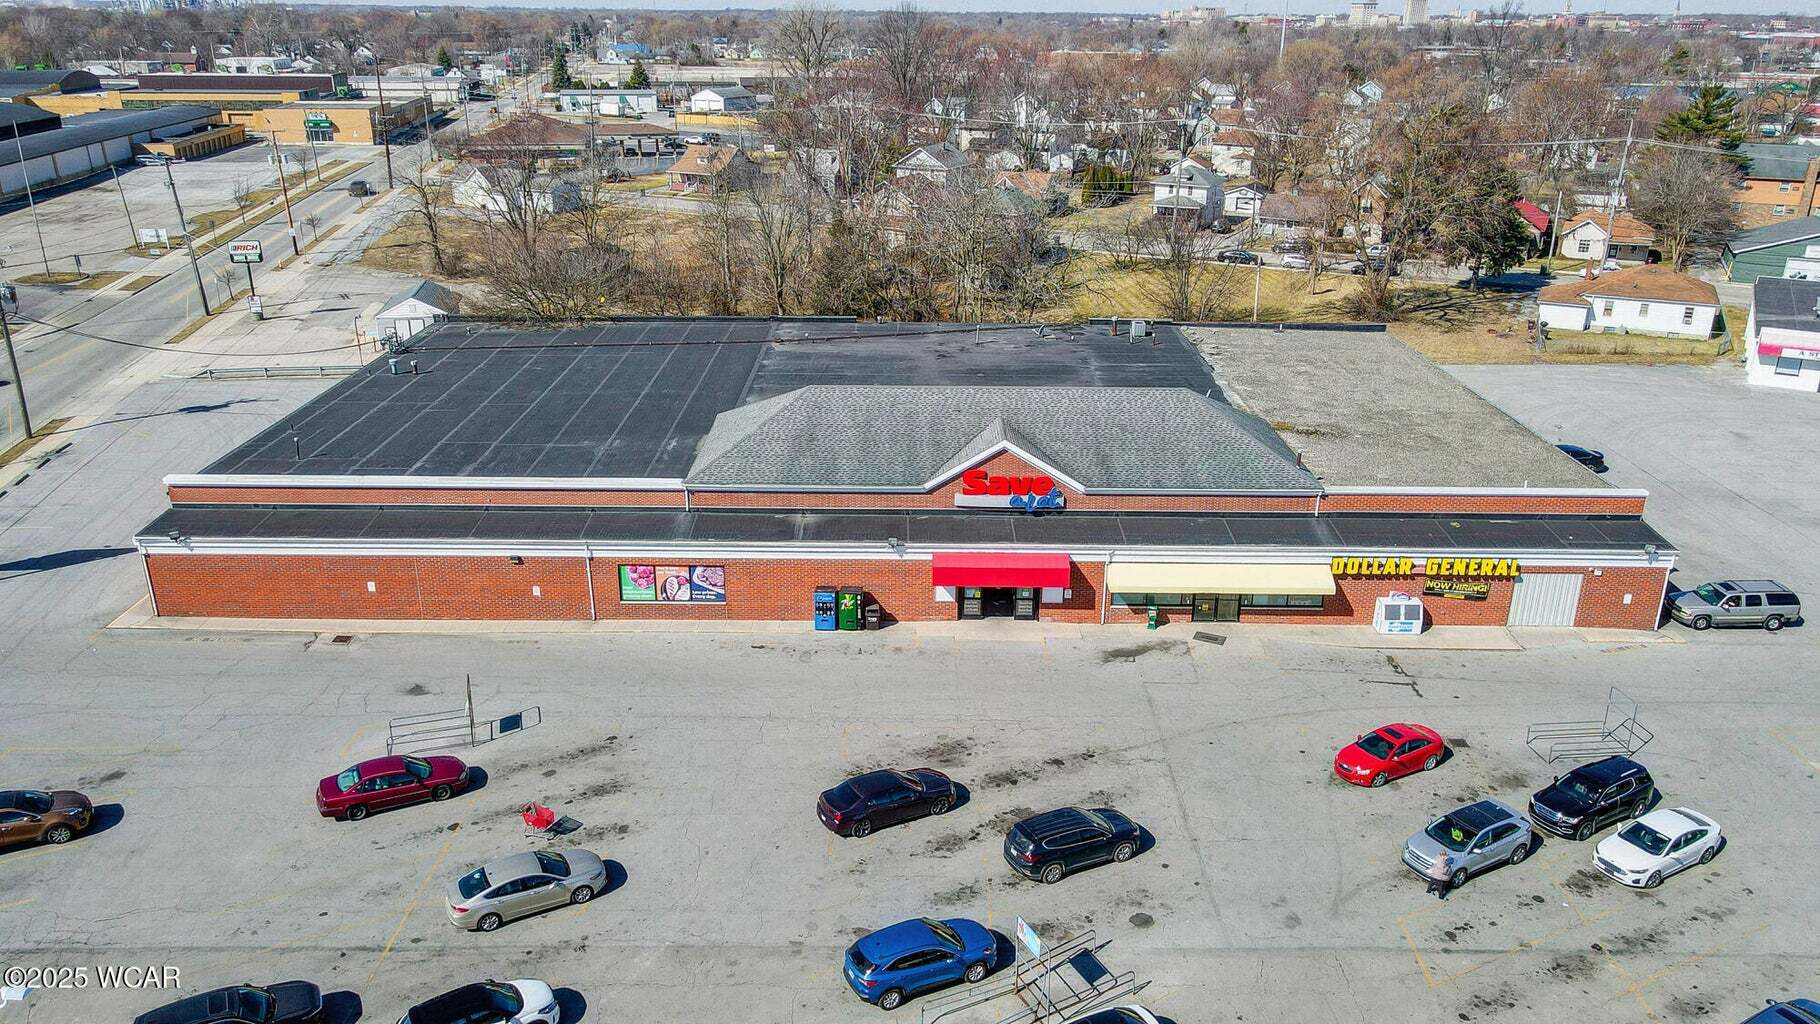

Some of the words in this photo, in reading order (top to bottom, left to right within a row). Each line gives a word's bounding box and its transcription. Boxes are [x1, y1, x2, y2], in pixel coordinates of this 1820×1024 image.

[962, 469, 1056, 496] Save
[1331, 556, 1415, 576] DOLLAR
[1425, 557, 1521, 577] GENERAL
[1426, 579, 1451, 590] NOW
